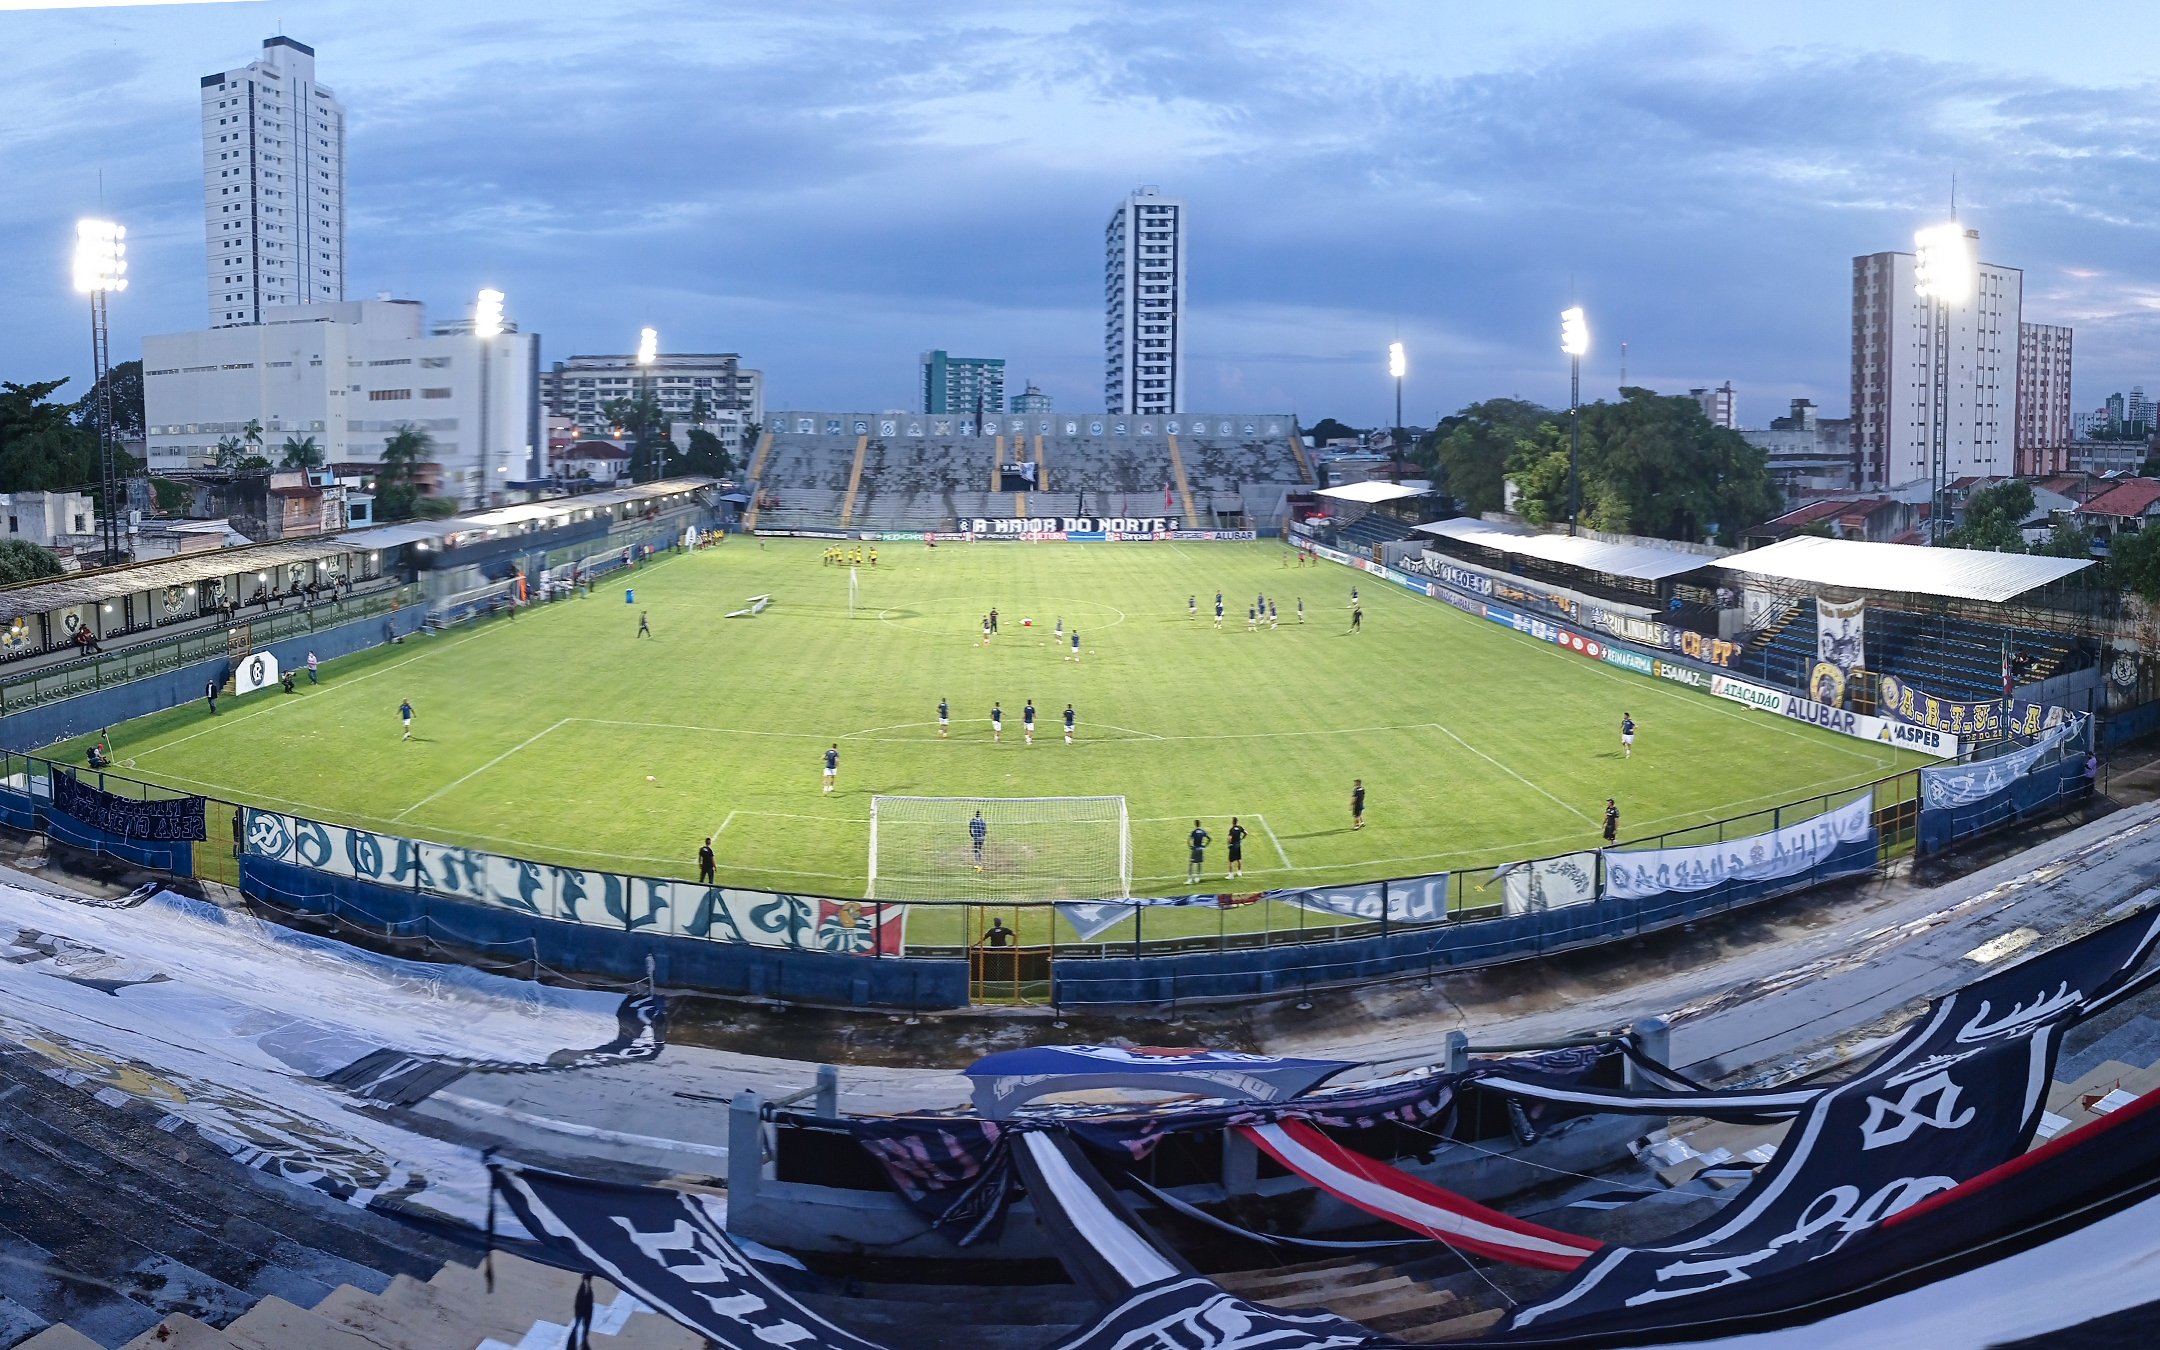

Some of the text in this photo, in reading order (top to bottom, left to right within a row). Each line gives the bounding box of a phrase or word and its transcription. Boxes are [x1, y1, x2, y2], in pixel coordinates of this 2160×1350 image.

[973, 518, 1167, 533] A MAIOR DO NORTE
[1215, 531, 1253, 540] ALUBAR
[1602, 610, 1662, 646] AZULINDAS
[1606, 651, 1651, 673] REINAFARMA
[1660, 663, 1700, 687] ESAMAZ
[1786, 697, 1856, 735] ALUBAR
